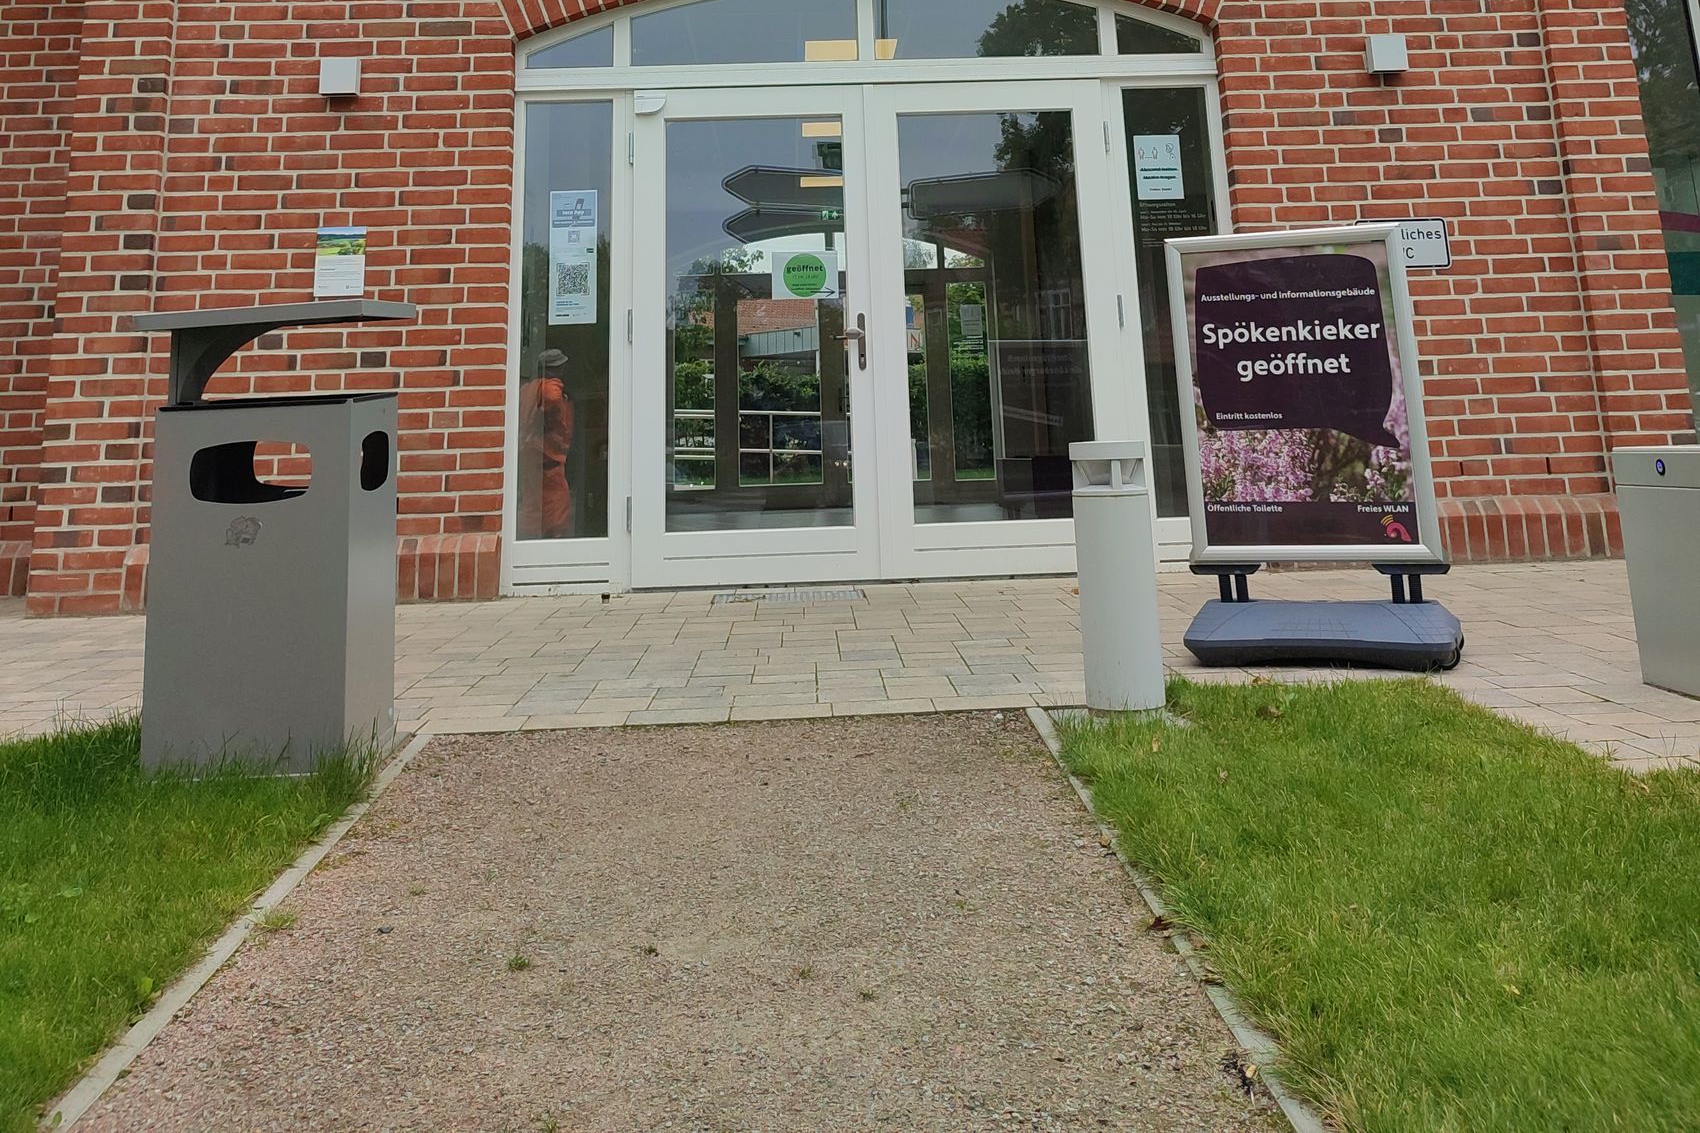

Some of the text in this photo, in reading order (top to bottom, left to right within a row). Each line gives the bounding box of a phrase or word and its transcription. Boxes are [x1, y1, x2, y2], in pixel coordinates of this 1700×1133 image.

[1401, 228, 1441, 240] liches
[787, 265, 823, 274] geöffnet
[1201, 294, 1259, 302] Ausstellungs-
[1279, 288, 1375, 298] Informationsgebäude
[1202, 319, 1380, 349] Spökenkieker
[1237, 352, 1351, 382] geöffnet
[1216, 412, 1244, 420] Eintritt
[1207, 504, 1283, 513] Öffentliche Toilette
[1357, 504, 1409, 513] Freies WLAN
